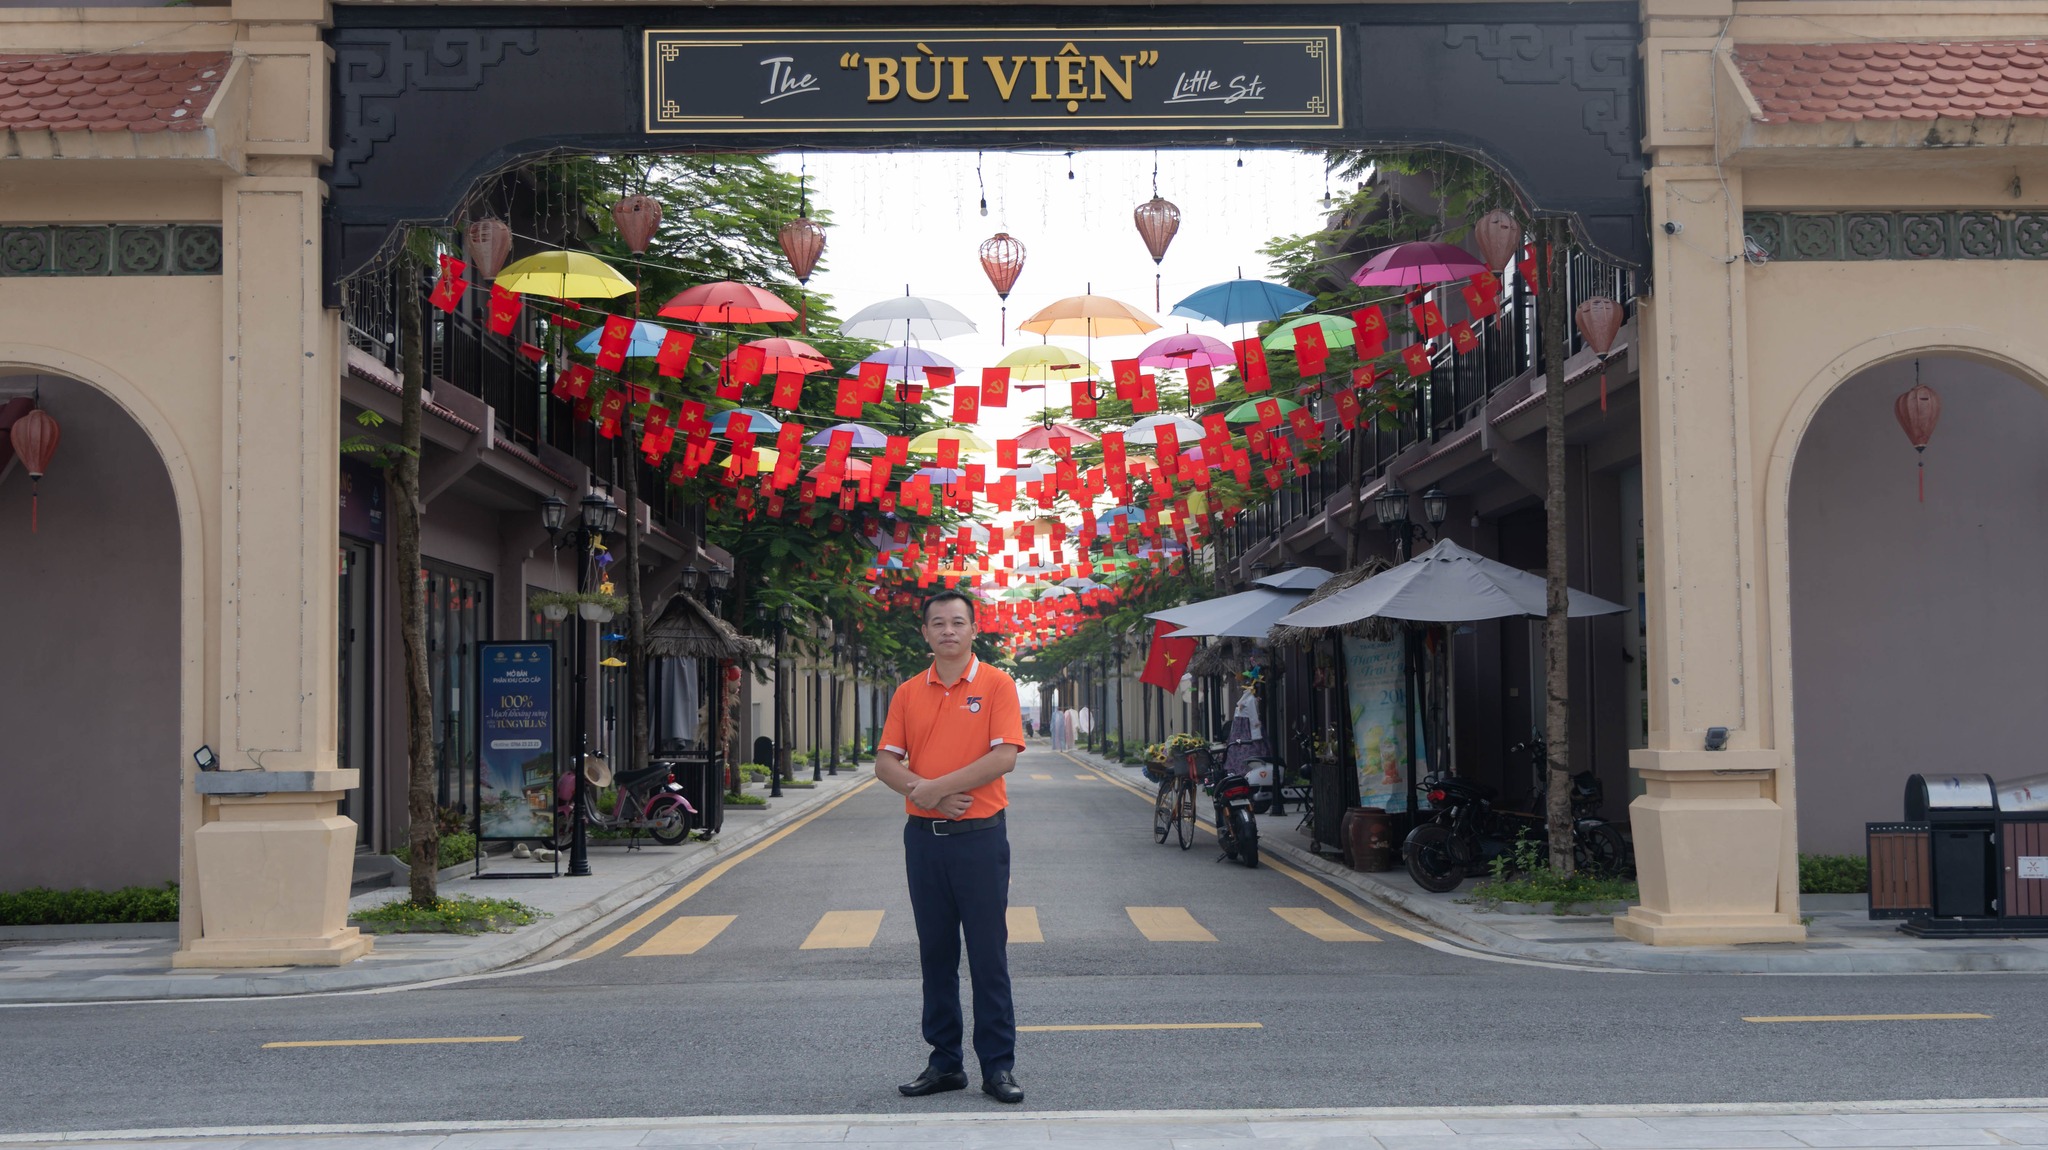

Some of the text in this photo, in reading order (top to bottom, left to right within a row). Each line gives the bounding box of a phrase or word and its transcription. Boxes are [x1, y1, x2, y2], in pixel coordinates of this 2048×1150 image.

[760, 56, 821, 98] The
[1171, 69, 1265, 103] Little Str
[501, 694, 533, 708] 100%
[519, 719, 547, 728] VILLAS
